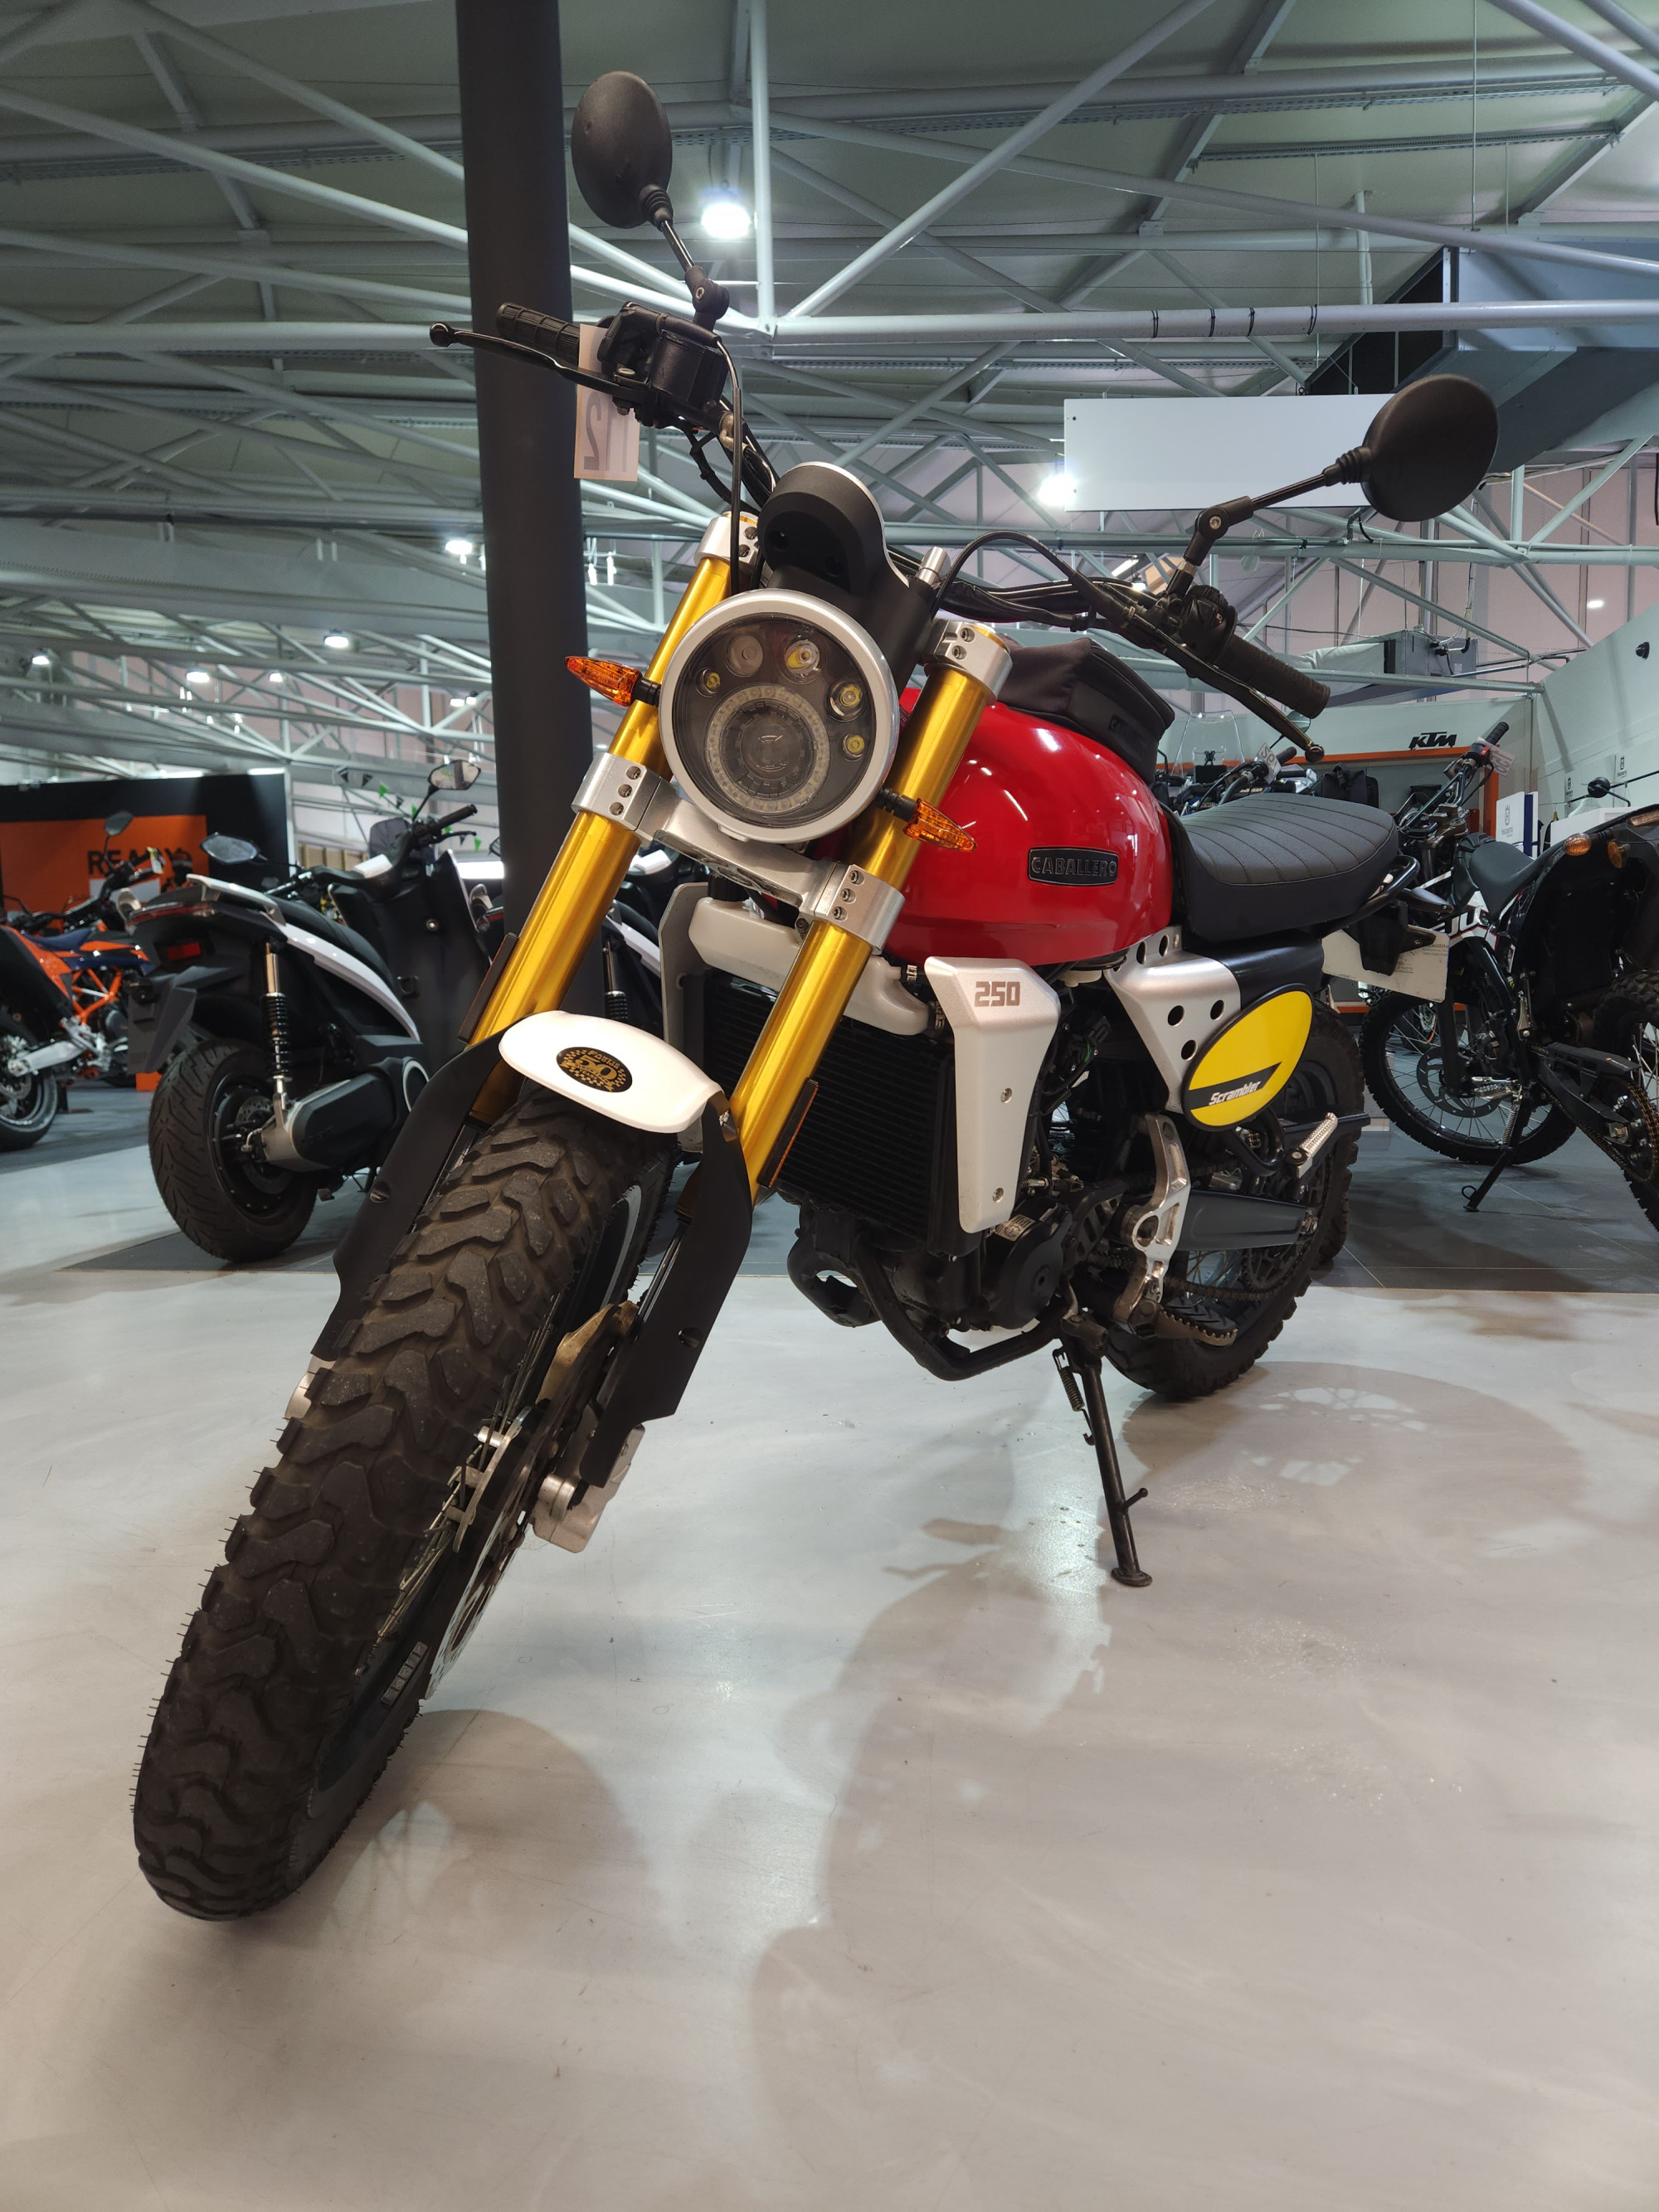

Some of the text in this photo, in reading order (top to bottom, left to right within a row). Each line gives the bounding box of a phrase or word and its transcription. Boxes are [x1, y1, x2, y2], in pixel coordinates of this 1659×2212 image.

[1408, 732, 1457, 750] KTM
[1031, 856, 1117, 877] CABALLERO
[975, 981, 1021, 1007] 250
[576, 1054, 617, 1080] 50
[1209, 1081, 1262, 1106] Scrambler
